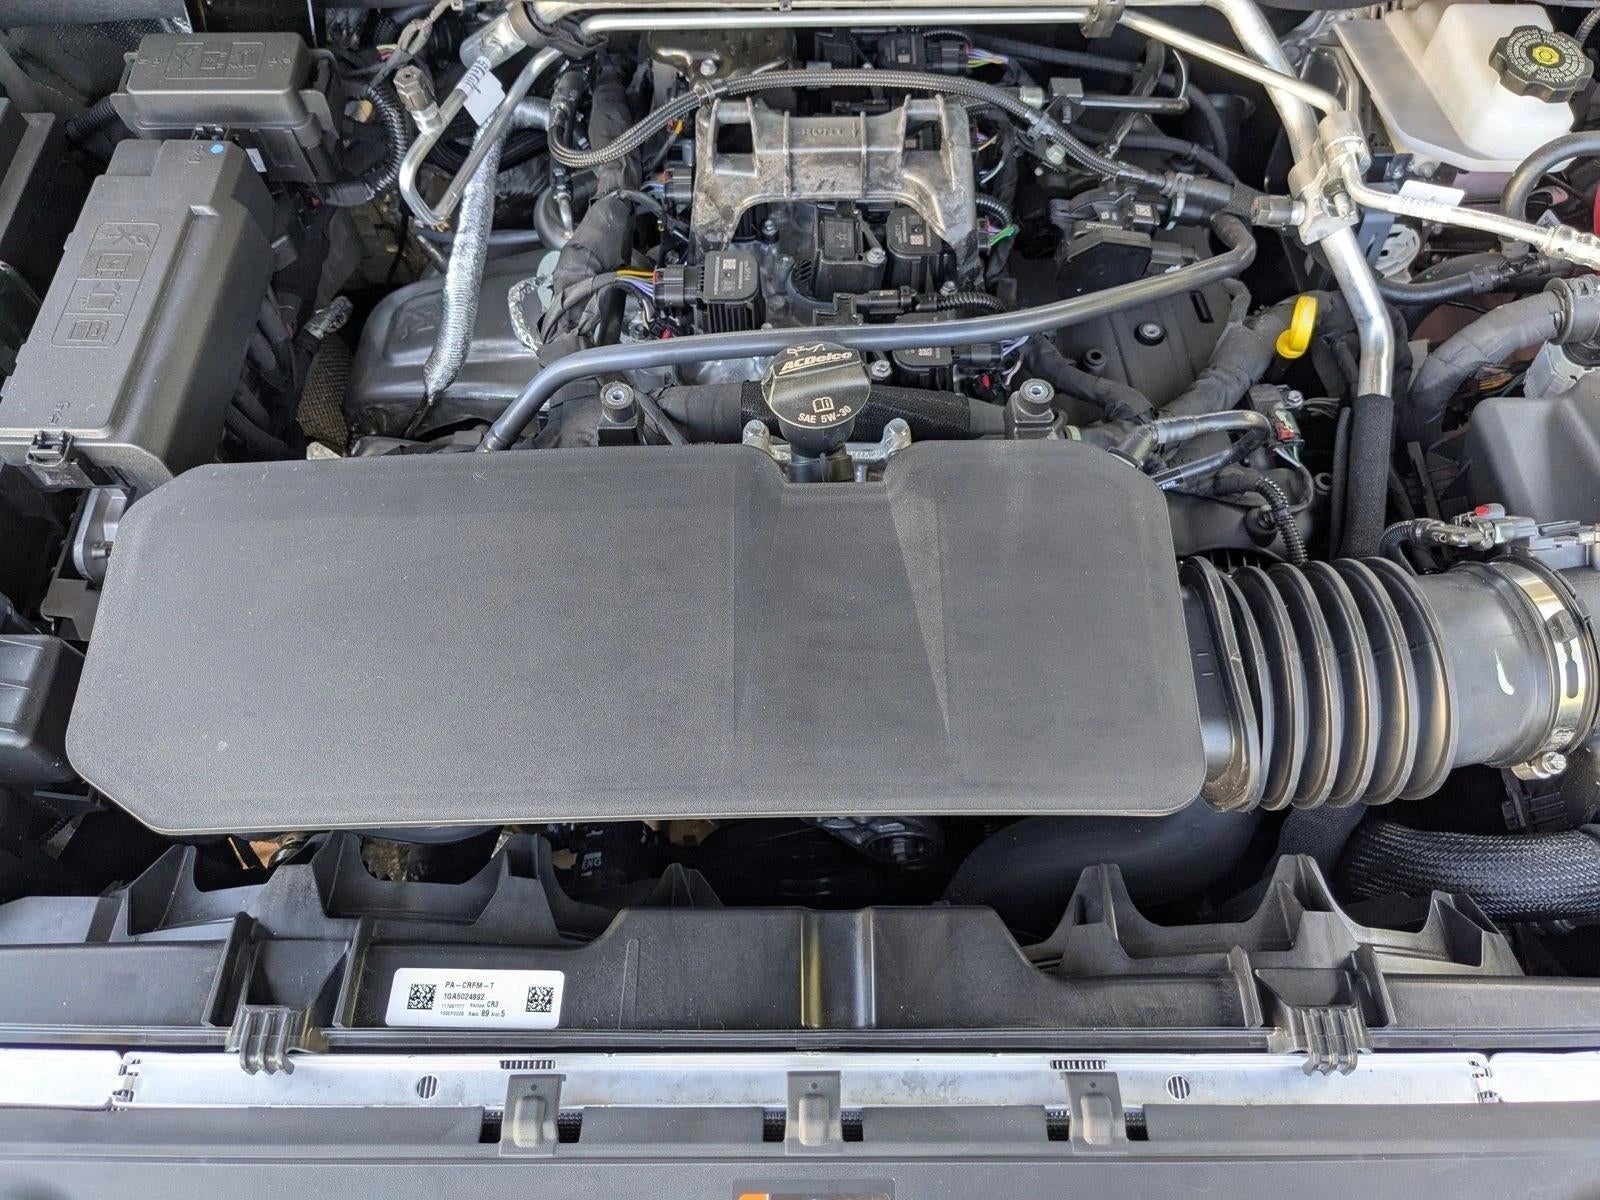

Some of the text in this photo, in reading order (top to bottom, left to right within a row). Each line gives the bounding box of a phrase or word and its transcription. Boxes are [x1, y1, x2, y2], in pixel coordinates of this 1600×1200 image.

[780, 351, 853, 372] ACDelco
[797, 404, 852, 424] SAE 5W-30
